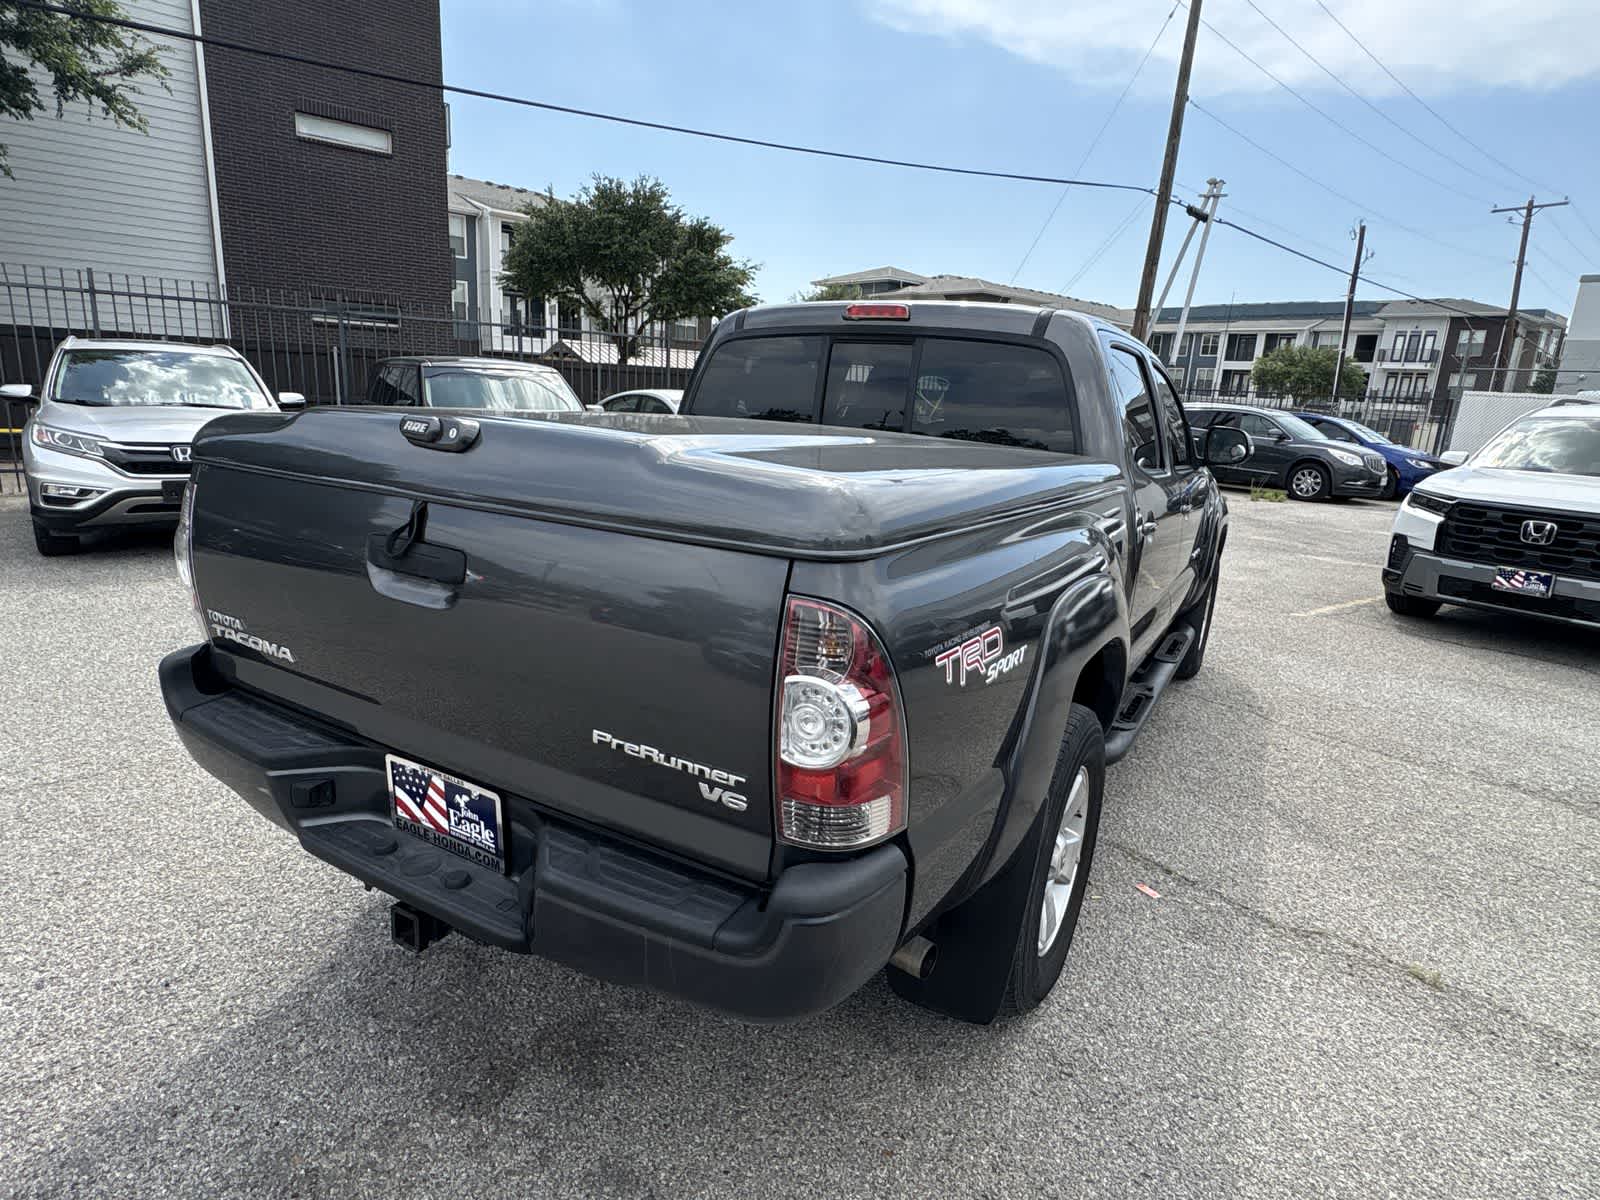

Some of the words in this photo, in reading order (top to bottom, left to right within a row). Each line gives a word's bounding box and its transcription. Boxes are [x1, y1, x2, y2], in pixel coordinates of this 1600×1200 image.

[207, 609, 243, 630] TOYOTA
[212, 623, 294, 663] TACOMA
[935, 626, 1003, 686] TRD
[986, 644, 1028, 684] SPORT
[592, 729, 746, 786] PreRunner
[460, 807, 479, 821] John
[699, 782, 748, 812] V6
[448, 807, 495, 843] Eagle
